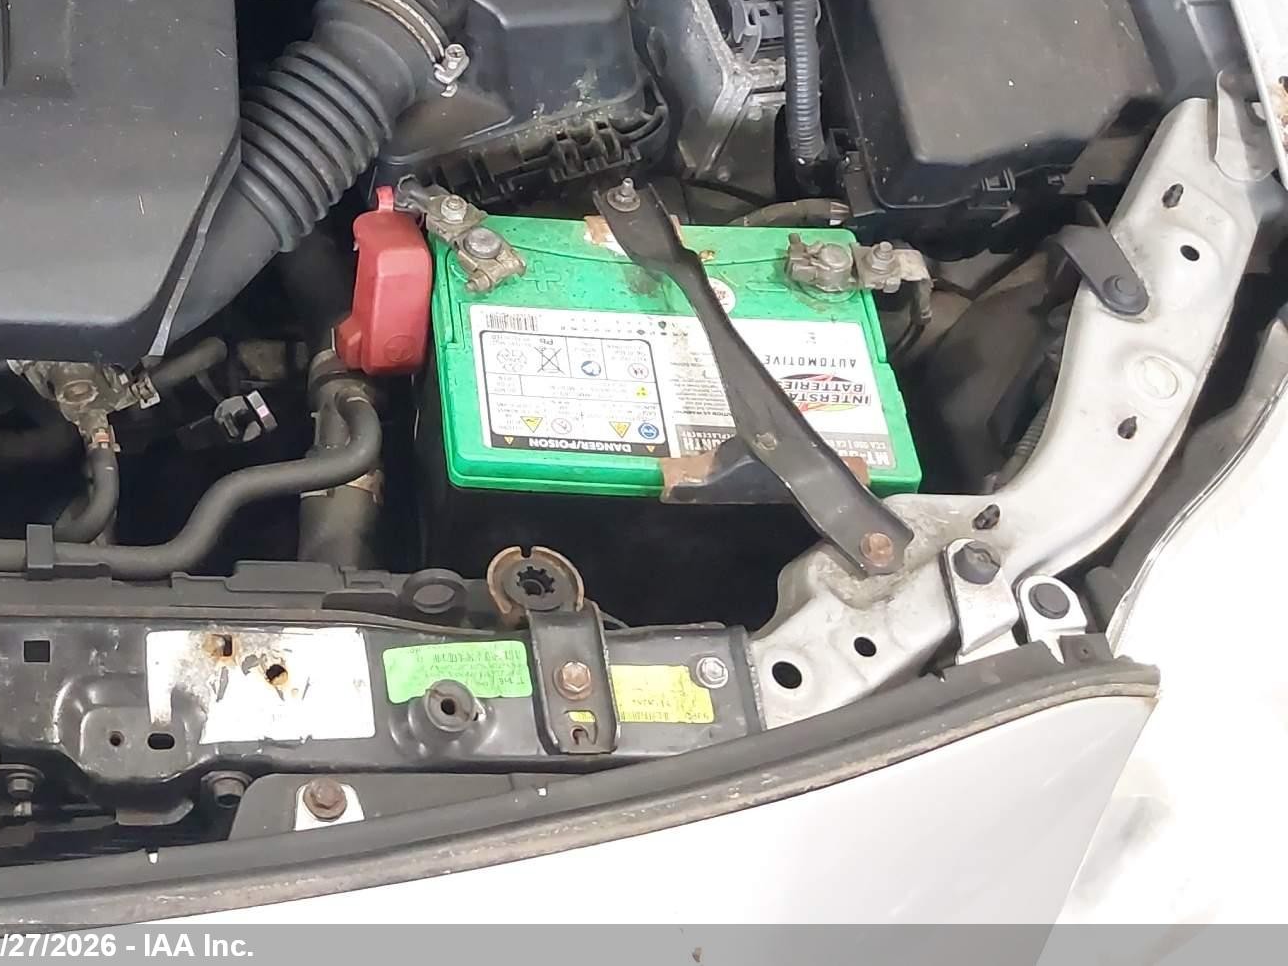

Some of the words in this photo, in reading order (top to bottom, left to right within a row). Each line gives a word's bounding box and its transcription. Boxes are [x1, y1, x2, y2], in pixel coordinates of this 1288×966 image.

[764, 354, 857, 368] AUTOMOTIVE
[789, 392, 869, 405] INTERSTA
[529, 437, 632, 453] DANGER/POISON
